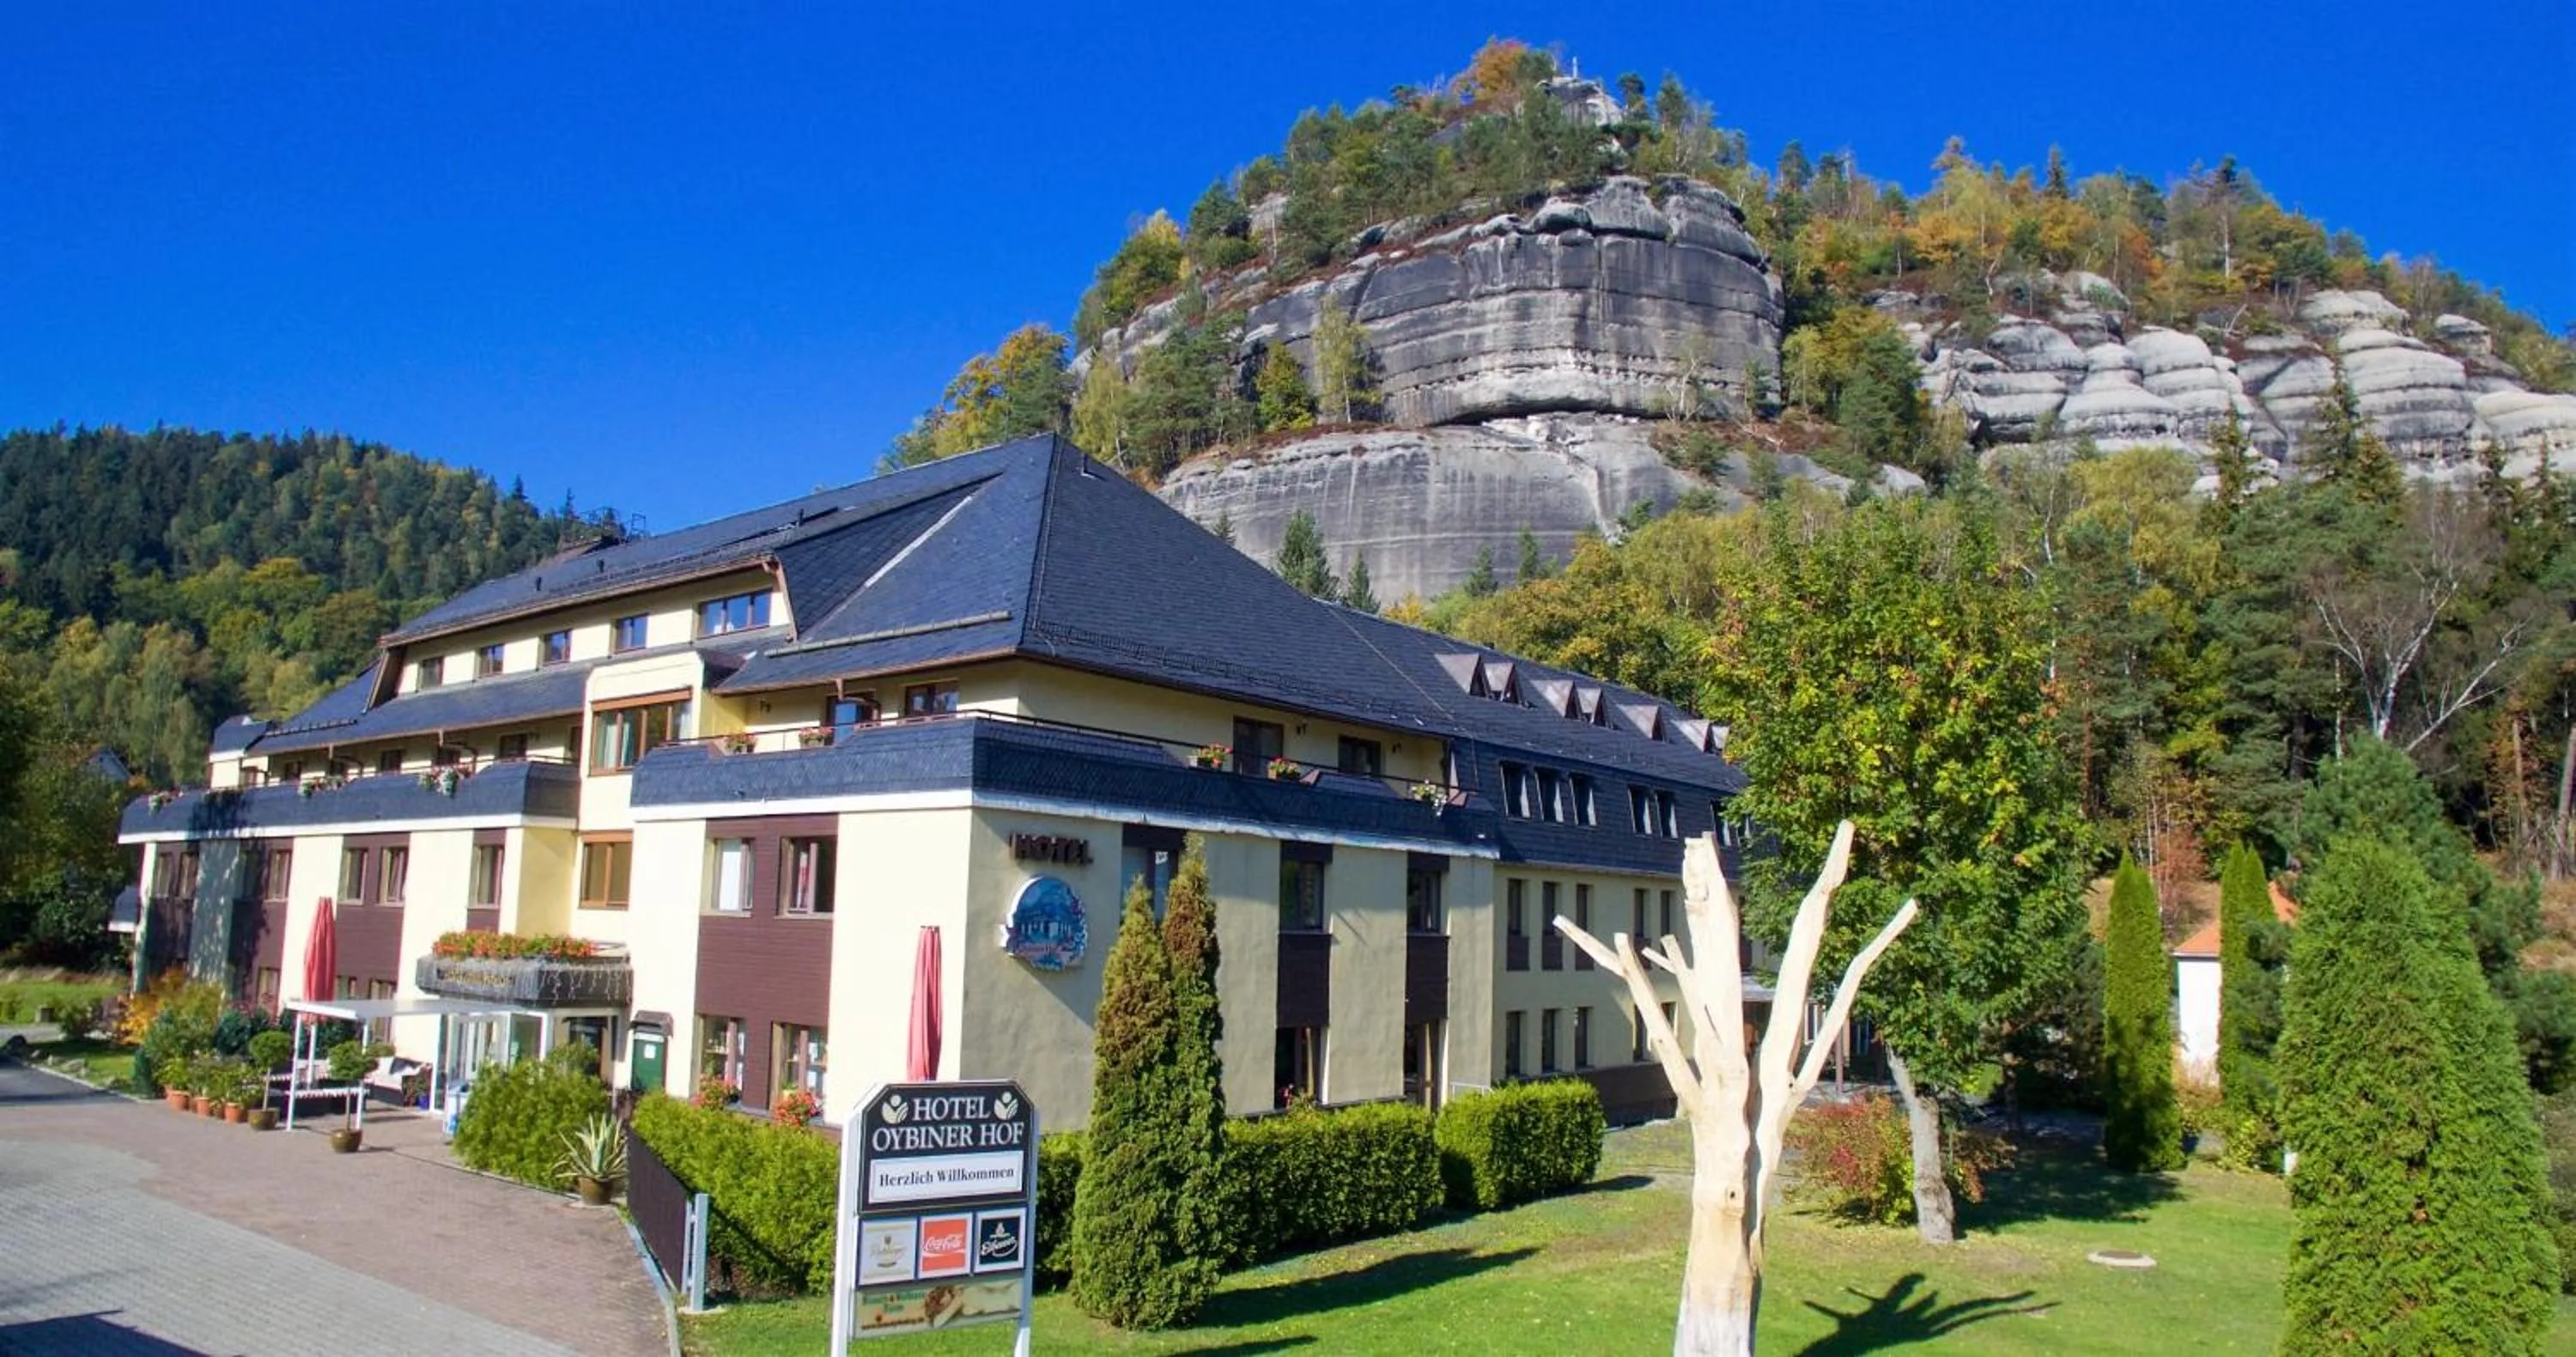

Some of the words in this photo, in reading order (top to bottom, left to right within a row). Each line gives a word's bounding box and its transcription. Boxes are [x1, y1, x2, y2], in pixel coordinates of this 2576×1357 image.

[1010, 831, 1094, 866] HOTEL
[912, 1096, 991, 1122] HOTEL
[872, 1123, 974, 1153] OYBINER
[978, 1121, 1024, 1147] HOF
[879, 1171, 933, 1188] Herzlich
[937, 1166, 1014, 1183] Willkommen
